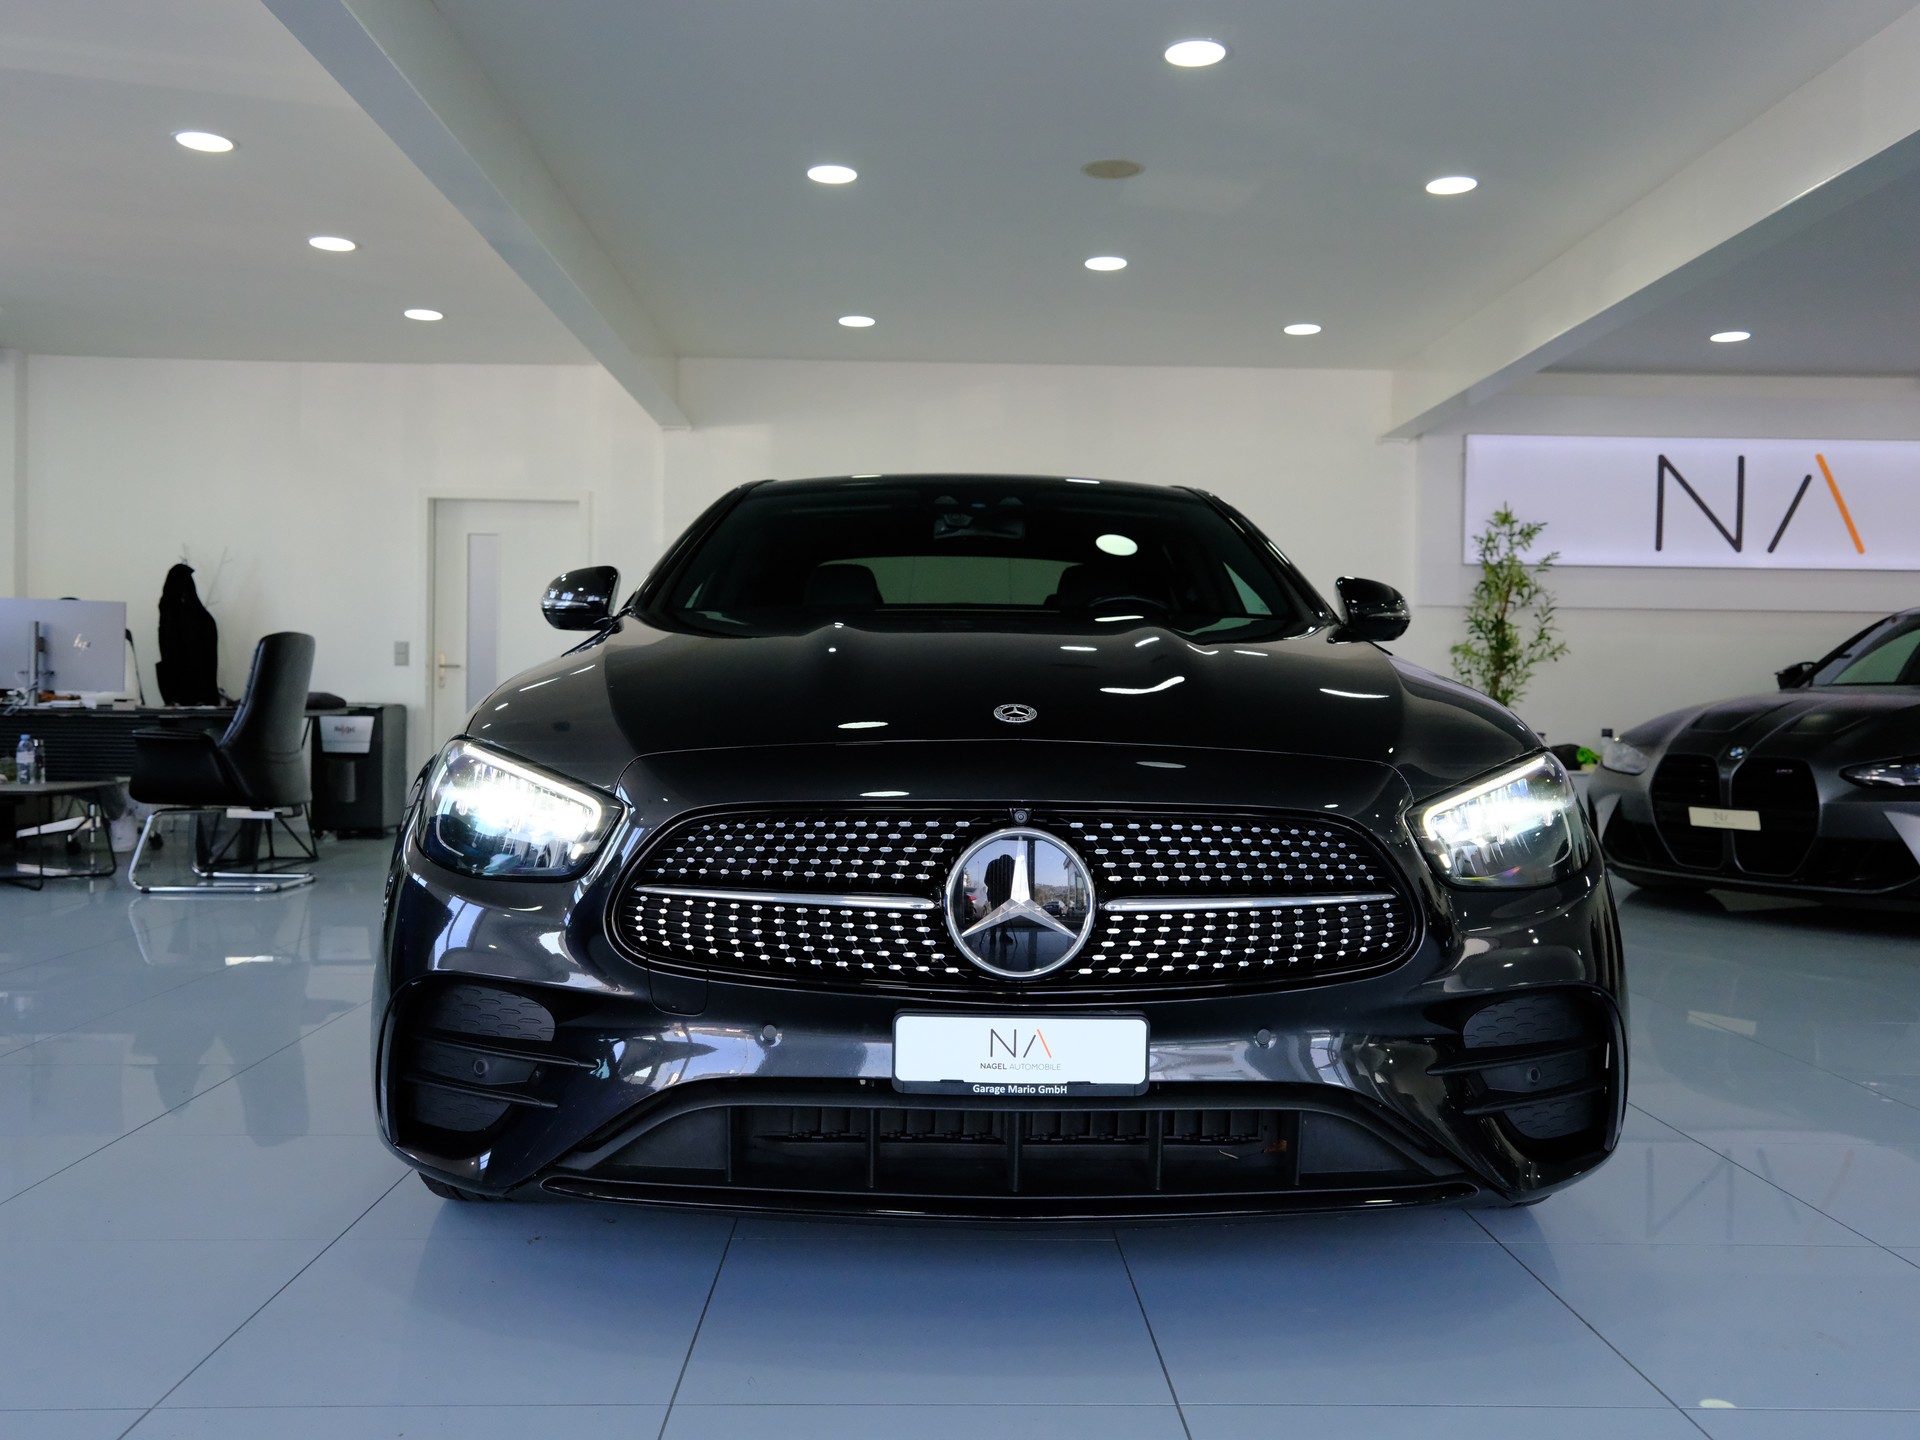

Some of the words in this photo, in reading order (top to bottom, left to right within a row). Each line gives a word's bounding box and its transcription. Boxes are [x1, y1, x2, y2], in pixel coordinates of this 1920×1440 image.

[1655, 453, 1866, 554] NA
[990, 1028, 1052, 1058] NA
[980, 1062, 1007, 1071] NAGEL
[1009, 1063, 1062, 1071] AUTOMOBILE
[972, 1084, 1006, 1095] Garage
[1008, 1084, 1036, 1094] Mario
[1038, 1085, 1068, 1095] GmbH
